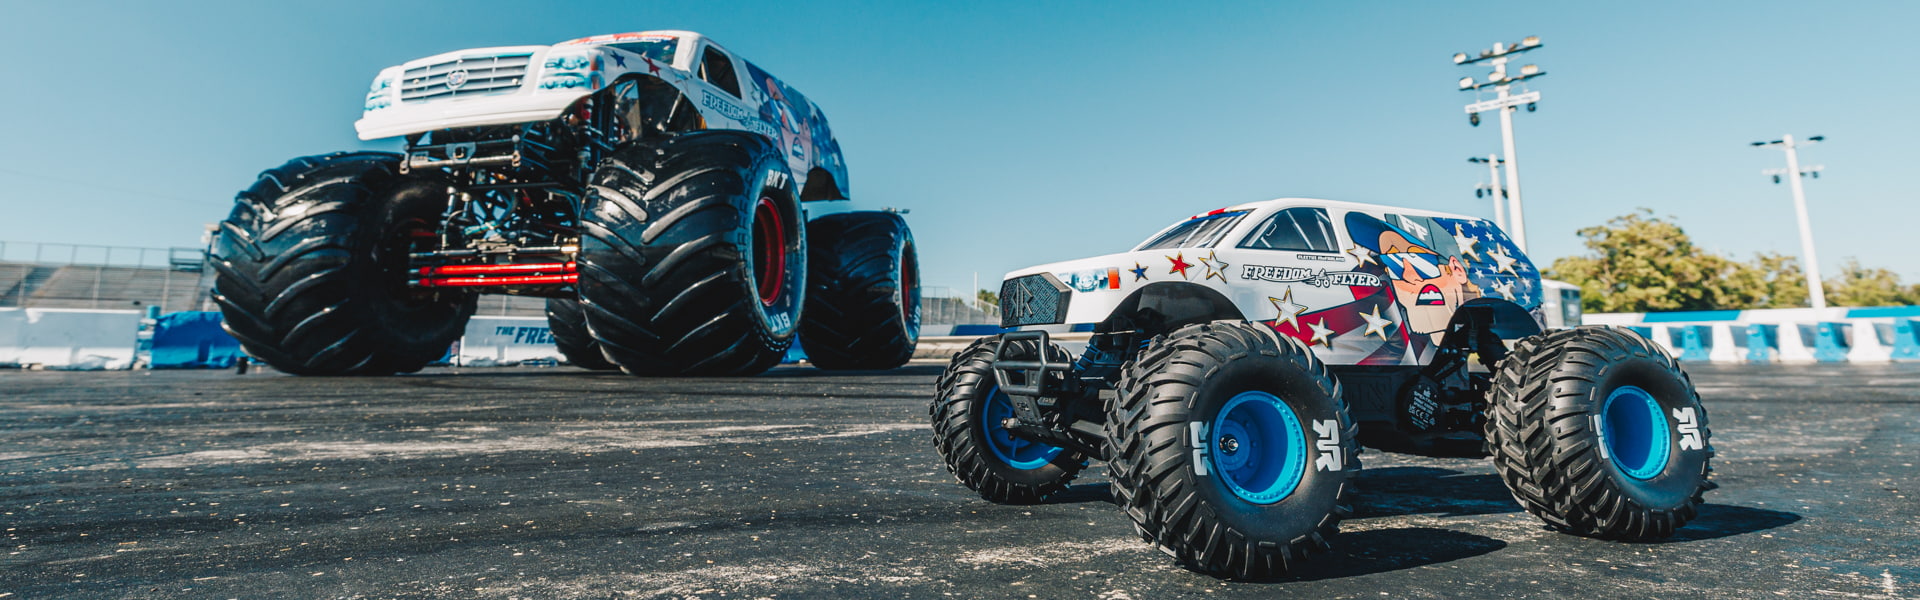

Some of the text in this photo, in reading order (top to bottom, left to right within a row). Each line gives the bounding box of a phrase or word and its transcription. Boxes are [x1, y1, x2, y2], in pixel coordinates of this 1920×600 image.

[766, 169, 788, 190] BKT
[1242, 264, 1381, 287] FREEDOM FLYER
[495, 326, 516, 336] THE
[770, 311, 791, 332] BKT
